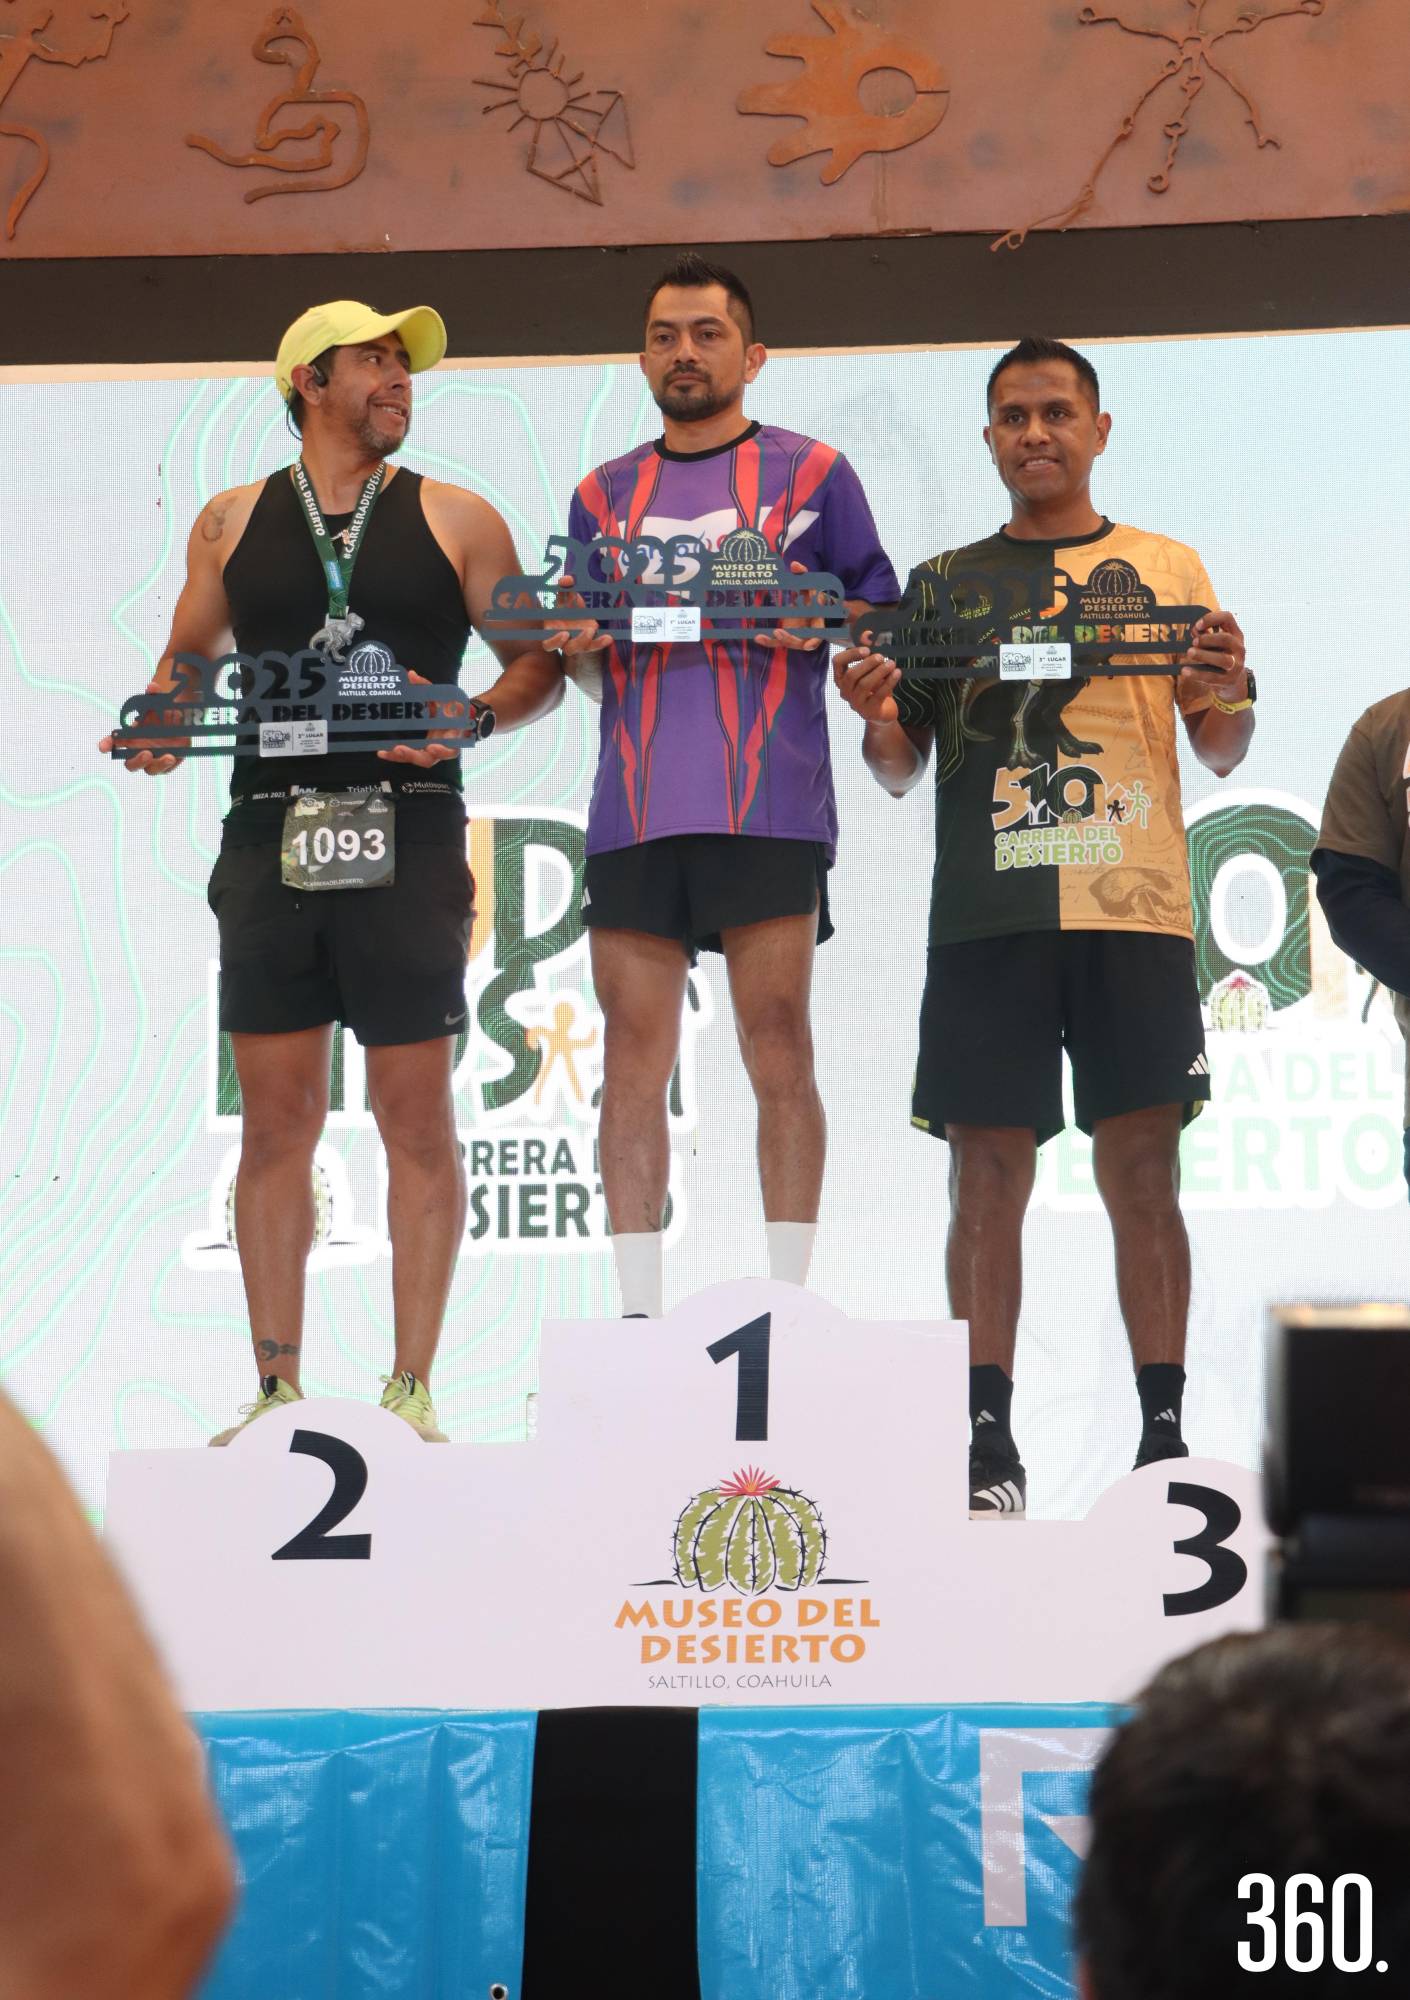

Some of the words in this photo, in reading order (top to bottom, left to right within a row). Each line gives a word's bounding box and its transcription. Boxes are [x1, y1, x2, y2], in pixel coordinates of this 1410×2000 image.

[295, 472, 308, 491] DEL
[303, 490, 326, 537] DESIERTO
[343, 460, 385, 560] #CARRERADELDESIER
[544, 542, 701, 585] 2025
[711, 563, 754, 572] MUSEO
[756, 562, 779, 572] DEL
[715, 570, 774, 579] DESIERTO
[744, 578, 779, 586] COAHUILA
[496, 589, 635, 610] CARRERA
[705, 588, 840, 608] DESIERTO
[1079, 596, 1123, 605] MUSEO
[1126, 595, 1150, 605] DEL
[1084, 604, 1144, 612] DESIERTO
[1113, 612, 1151, 620] COAHUILA
[1011, 624, 1066, 644] DEL
[1073, 622, 1192, 644] DESIERT
[173, 656, 328, 703] 2025
[338, 675, 378, 683] MUSEO
[380, 675, 402, 683] DEL
[342, 682, 396, 690] DESIERTO
[123, 706, 262, 728] CARRERA
[271, 704, 323, 722] DEL
[331, 701, 465, 721] DESIERTO
[290, 826, 387, 866] 1093
[994, 826, 1082, 849] CARRERA
[1084, 826, 1121, 843] DEL
[994, 842, 1124, 872] DESIERTO
[1284, 1051, 1394, 1103] DEL
[458, 1137, 578, 1177] RERA
[469, 1181, 674, 1241] SIER
[705, 1311, 772, 1441] 1
[270, 1428, 372, 1561] 2
[1162, 1481, 1248, 1617] 3
[614, 1598, 782, 1629] MUSEO
[797, 1598, 881, 1628] DEL
[640, 1633, 867, 1664] DESIERTO
[648, 1674, 731, 1690] SALTILLO,
[736, 1674, 833, 1689] COAHUILA
